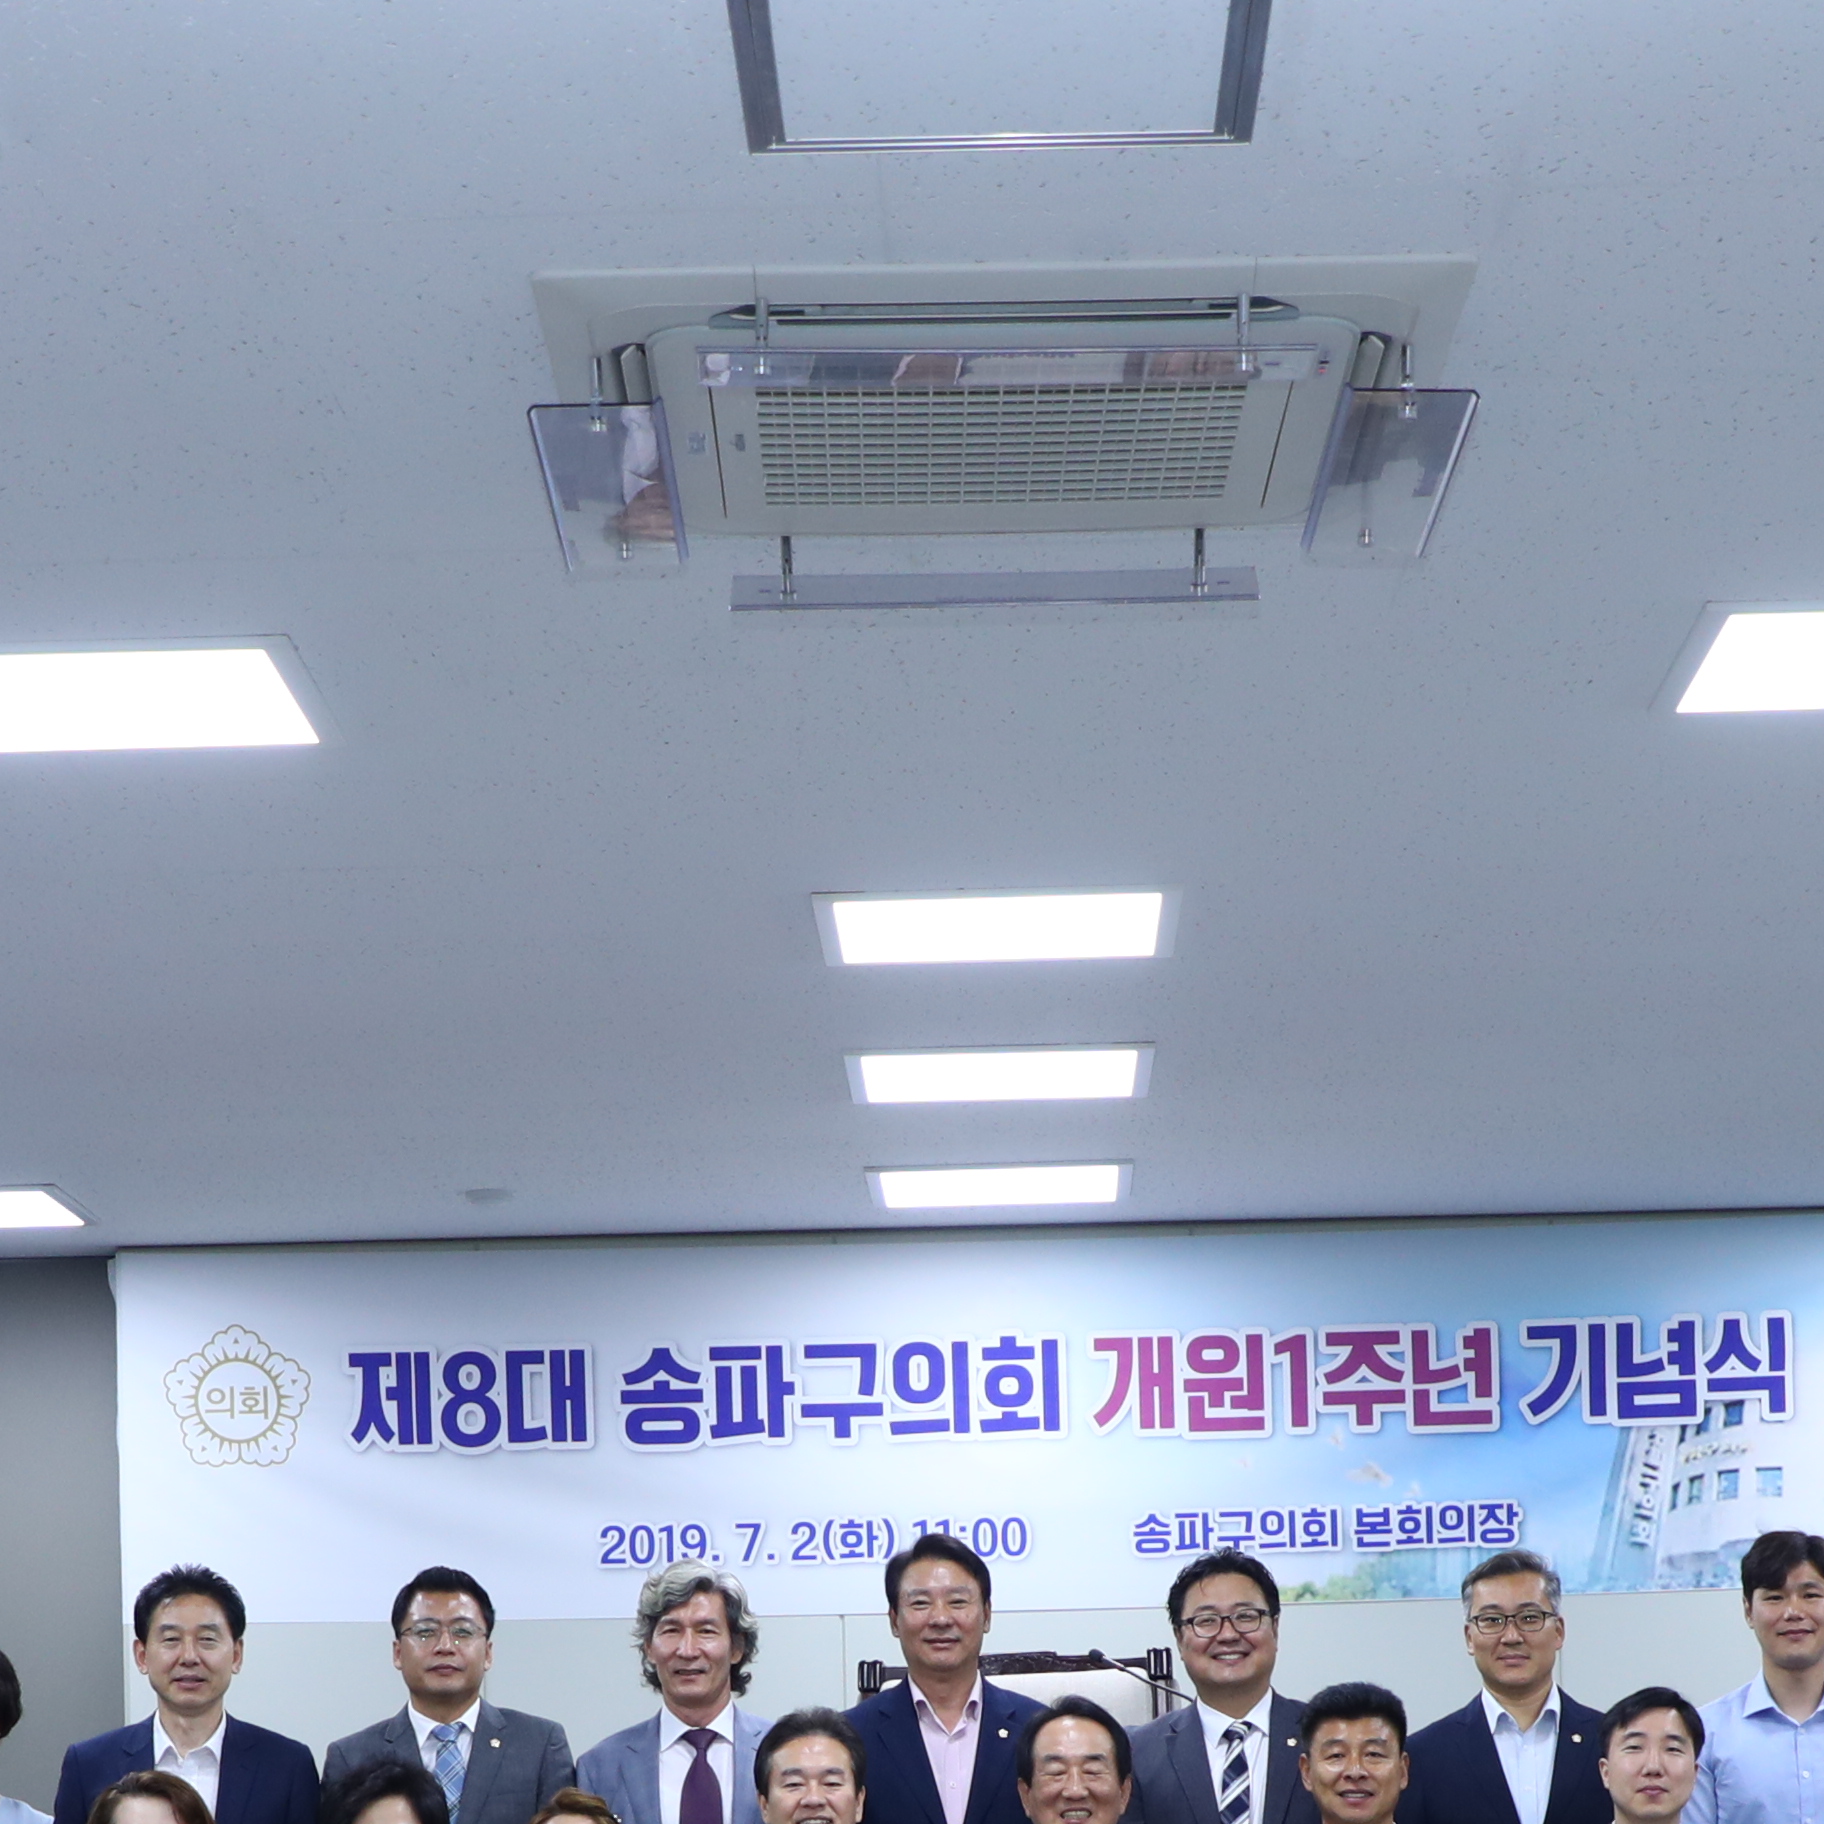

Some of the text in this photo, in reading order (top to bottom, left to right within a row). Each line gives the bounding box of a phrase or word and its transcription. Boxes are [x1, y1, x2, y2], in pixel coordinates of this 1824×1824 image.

[205, 1384, 271, 1420] 의회
[347, 1316, 1786, 1449] 제8대 송파구의회 개원1주년 기념식
[600, 1524, 721, 1564] 2019.
[735, 1522, 776, 1562] 7.
[791, 1517, 895, 1561] 2(화)
[1133, 1502, 1520, 1554] 송파구의회 본회의장
